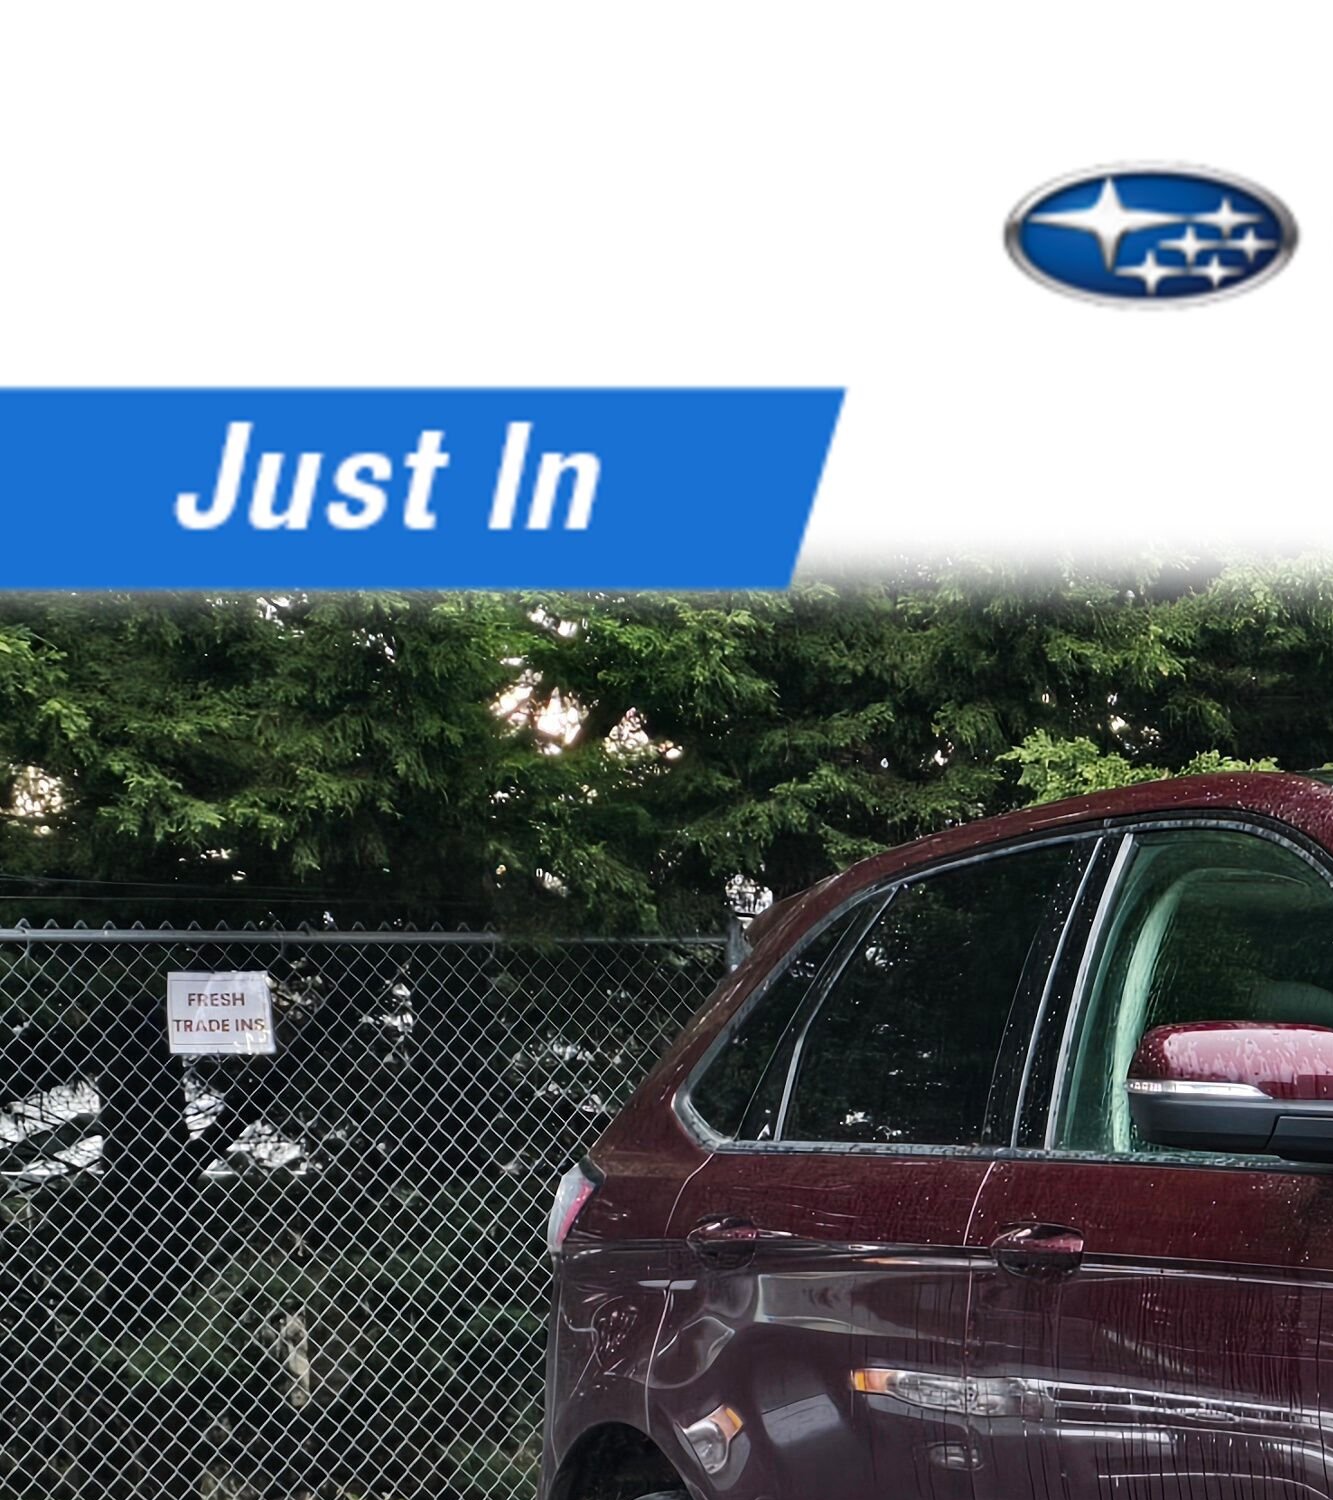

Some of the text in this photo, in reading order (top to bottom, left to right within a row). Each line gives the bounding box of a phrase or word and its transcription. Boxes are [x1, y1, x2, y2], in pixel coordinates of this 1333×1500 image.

[187, 992, 246, 1007] FRESH
[172, 1017, 265, 1033] TRADE INS
